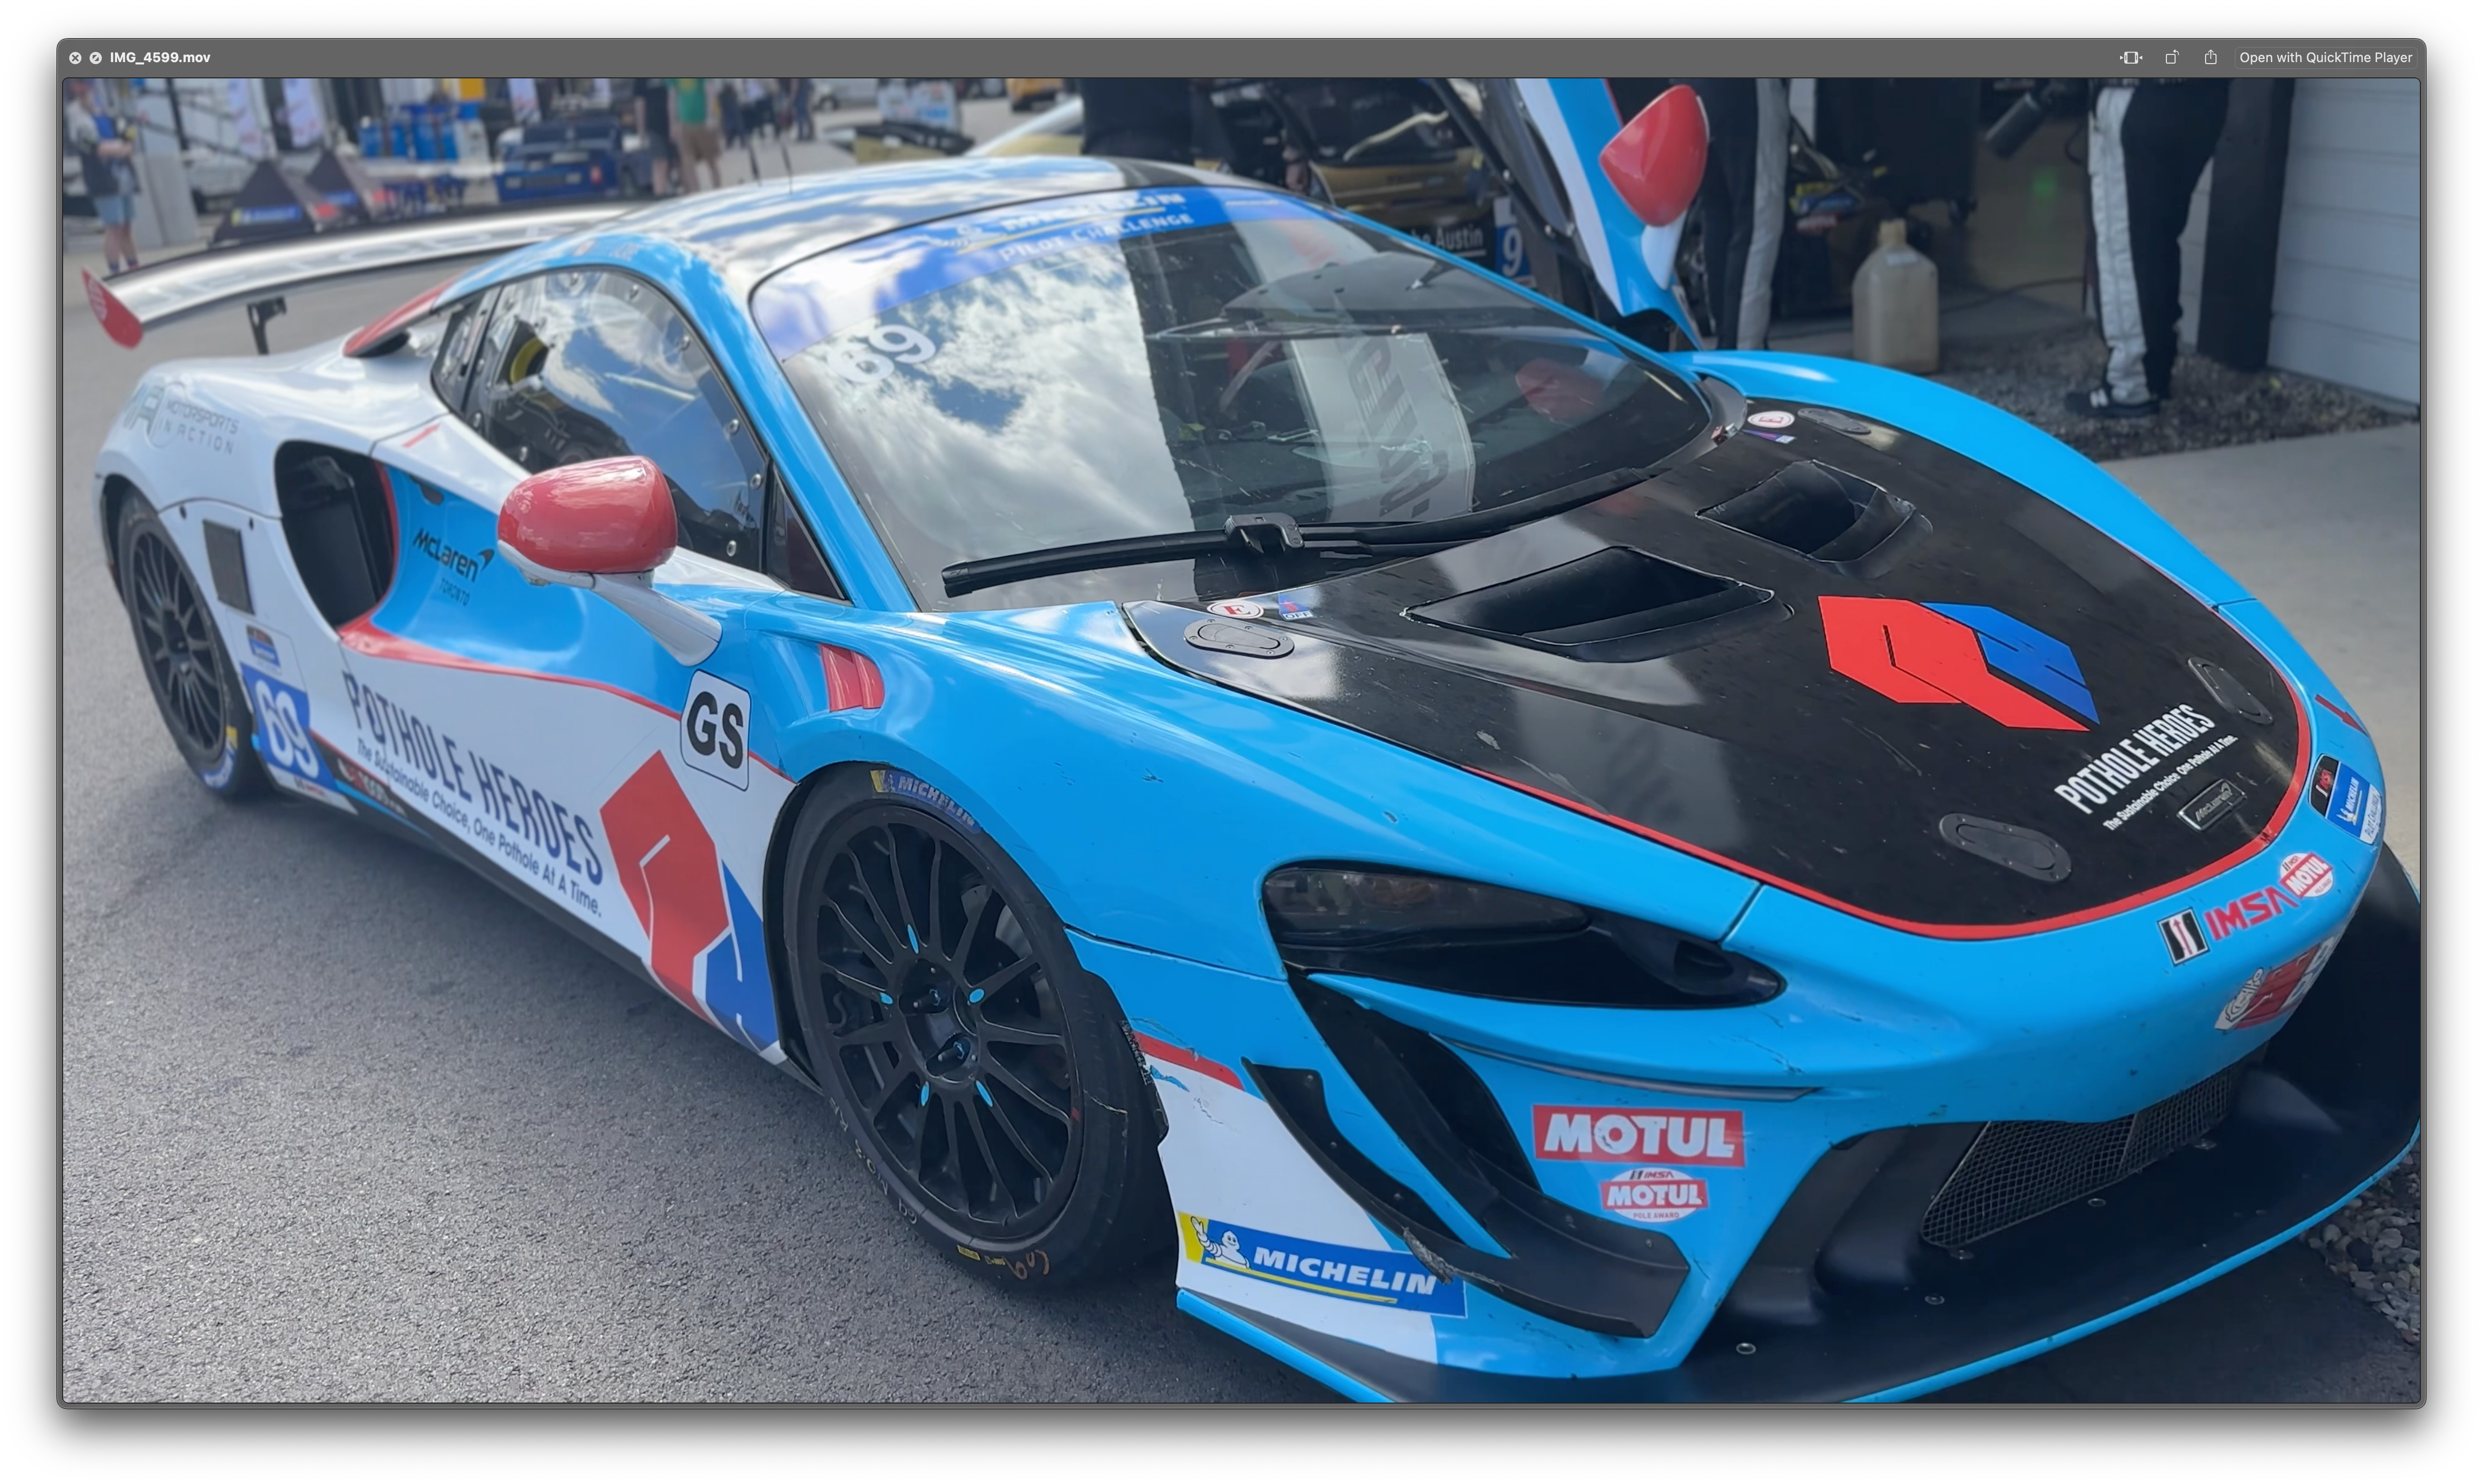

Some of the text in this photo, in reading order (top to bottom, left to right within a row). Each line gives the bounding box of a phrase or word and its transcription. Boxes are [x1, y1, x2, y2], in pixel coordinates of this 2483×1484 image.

[1436, 223, 1483, 249] Austin
[827, 324, 936, 384] 69
[167, 399, 239, 435] MOTORSPORTS
[178, 423, 235, 455] ACTION
[412, 528, 478, 583] McLaren
[440, 578, 470, 607] TORONTO
[1223, 605, 1251, 615] E
[255, 679, 319, 779] 69
[687, 691, 744, 769] GS
[342, 670, 472, 803] POTHOLE
[468, 750, 603, 886] HEROES
[2054, 704, 2216, 815] POTHOLE HEROES
[2103, 817, 2122, 831] The
[2116, 788, 2159, 821] Sustainable
[2176, 762, 2194, 776] One
[2187, 749, 2214, 767] Pothole
[2345, 777, 2359, 812] MICHELIN
[357, 737, 373, 762] The
[374, 750, 430, 802] Sustainable
[433, 790, 471, 833] Choice,
[474, 818, 496, 846] One
[499, 834, 540, 875] Pothole
[543, 864, 556, 886] At
[558, 877, 568, 895] A
[571, 879, 602, 917] Time.
[2286, 856, 2329, 896] MOTUL
[2204, 886, 2299, 941] IMSA
[1543, 1113, 1735, 1158] MOTUL
[1606, 1184, 1703, 1206] MOTUL
[1254, 1246, 1437, 1295] MICHELIN
